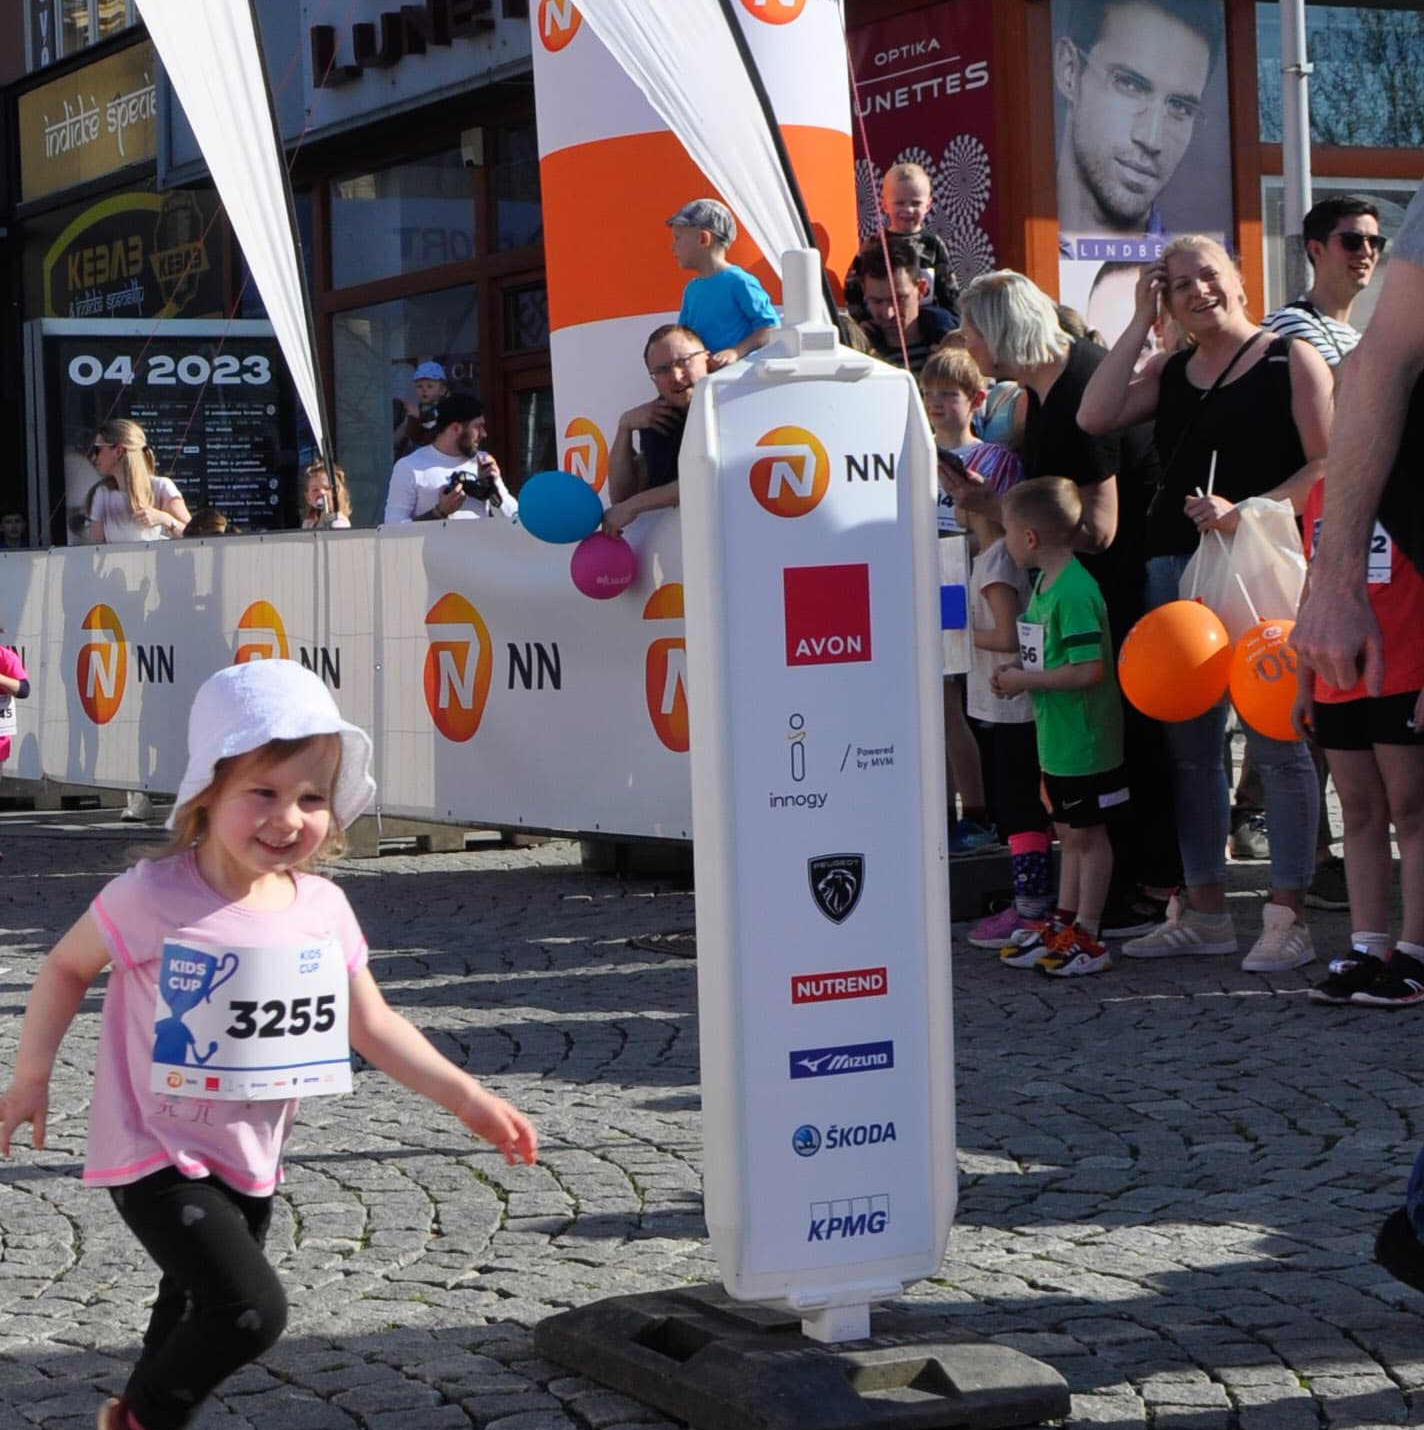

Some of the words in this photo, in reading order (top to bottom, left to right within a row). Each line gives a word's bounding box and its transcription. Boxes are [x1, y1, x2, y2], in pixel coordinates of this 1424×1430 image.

[874, 37, 941, 67] OPTIKA
[853, 60, 990, 118] UNETTES
[68, 355, 135, 386] 04
[147, 354, 271, 386] 2023
[845, 452, 895, 483] NN
[795, 635, 862, 658] AVON
[137, 644, 174, 684] NN
[300, 646, 341, 690] NN
[507, 642, 562, 691] NN
[856, 744, 895, 757] Powered
[857, 758, 869, 770] by
[871, 754, 895, 767] MVM
[769, 790, 829, 809] innogy
[169, 958, 207, 977] KIDS
[300, 949, 323, 962] KIDS
[300, 962, 320, 974] CUP
[168, 977, 202, 993] CUP
[796, 973, 884, 998] NUTREND
[226, 995, 336, 1040] 3255
[825, 1121, 898, 1150] ŠKODA
[807, 1210, 887, 1243] KPMG
